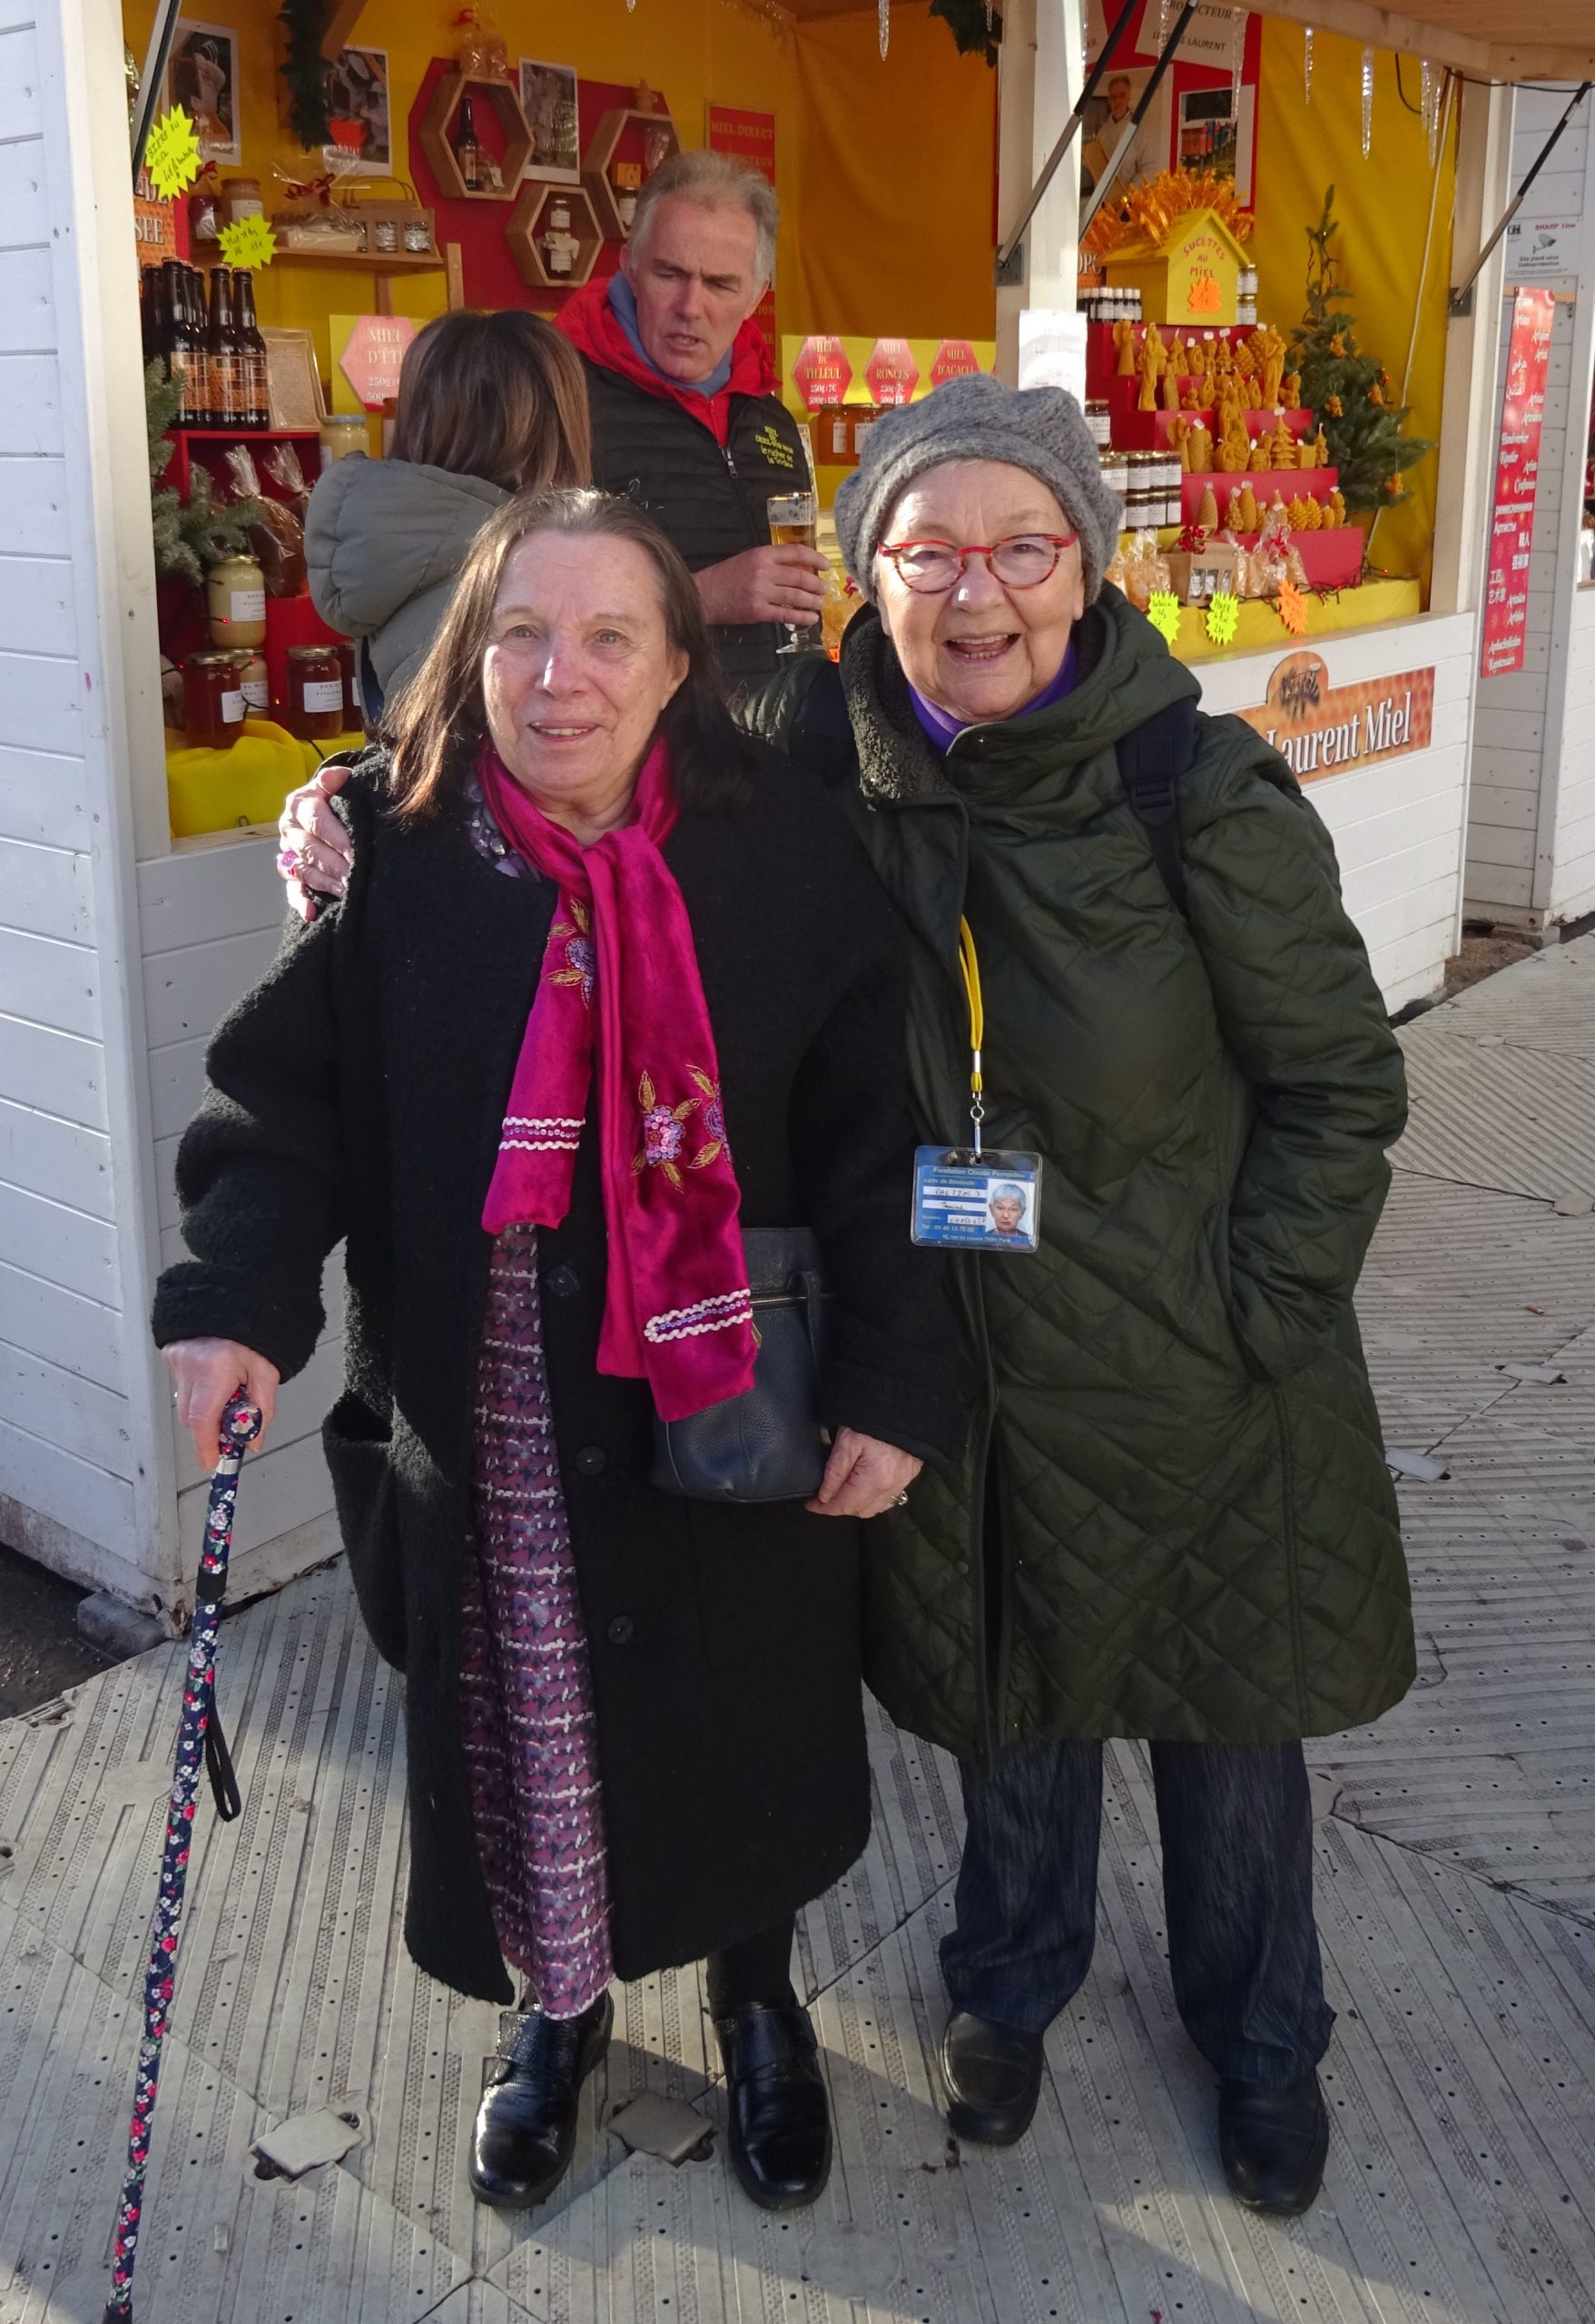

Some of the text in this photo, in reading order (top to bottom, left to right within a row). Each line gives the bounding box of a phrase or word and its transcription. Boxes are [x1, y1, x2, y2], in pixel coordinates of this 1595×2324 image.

[1187, 38, 1226, 51] LAURENT
[1183, 237, 1226, 261] SUCETTES
[1196, 254, 1208, 262] AU
[369, 328, 402, 342] MIEL
[812, 340, 832, 352] MIEL
[882, 341, 901, 353] MIEL
[947, 349, 966, 359] MIEL
[818, 356, 828, 364] DE
[805, 368, 841, 379] TILLEUL
[876, 369, 909, 379] RONCES
[937, 365, 974, 376] D'ACACIA
[1364, 692, 1411, 754] Miel
[933, 1167, 966, 1176] Fondation
